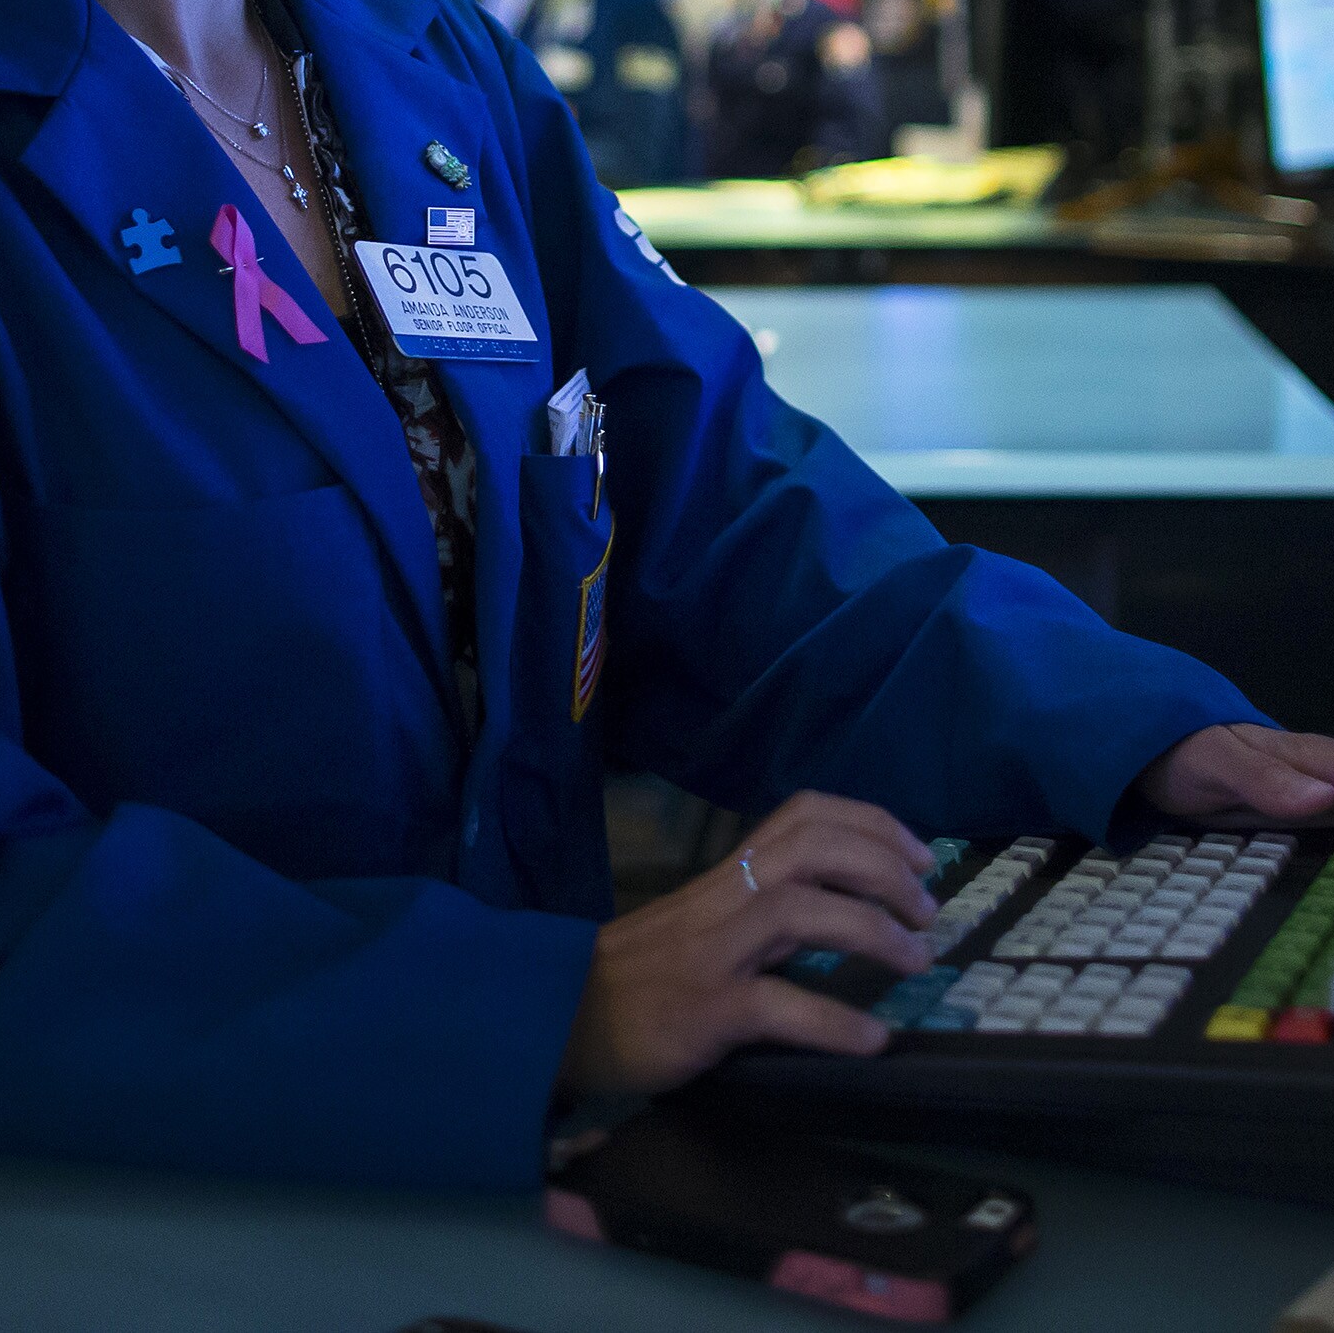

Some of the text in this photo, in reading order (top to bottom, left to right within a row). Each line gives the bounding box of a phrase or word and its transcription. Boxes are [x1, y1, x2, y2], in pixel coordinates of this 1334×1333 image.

[382, 247, 492, 299] 6105
[401, 300, 510, 321] AMANDA ANDERSON
[413, 318, 444, 331] SENIOR
[447, 320, 474, 333] FLOOR
